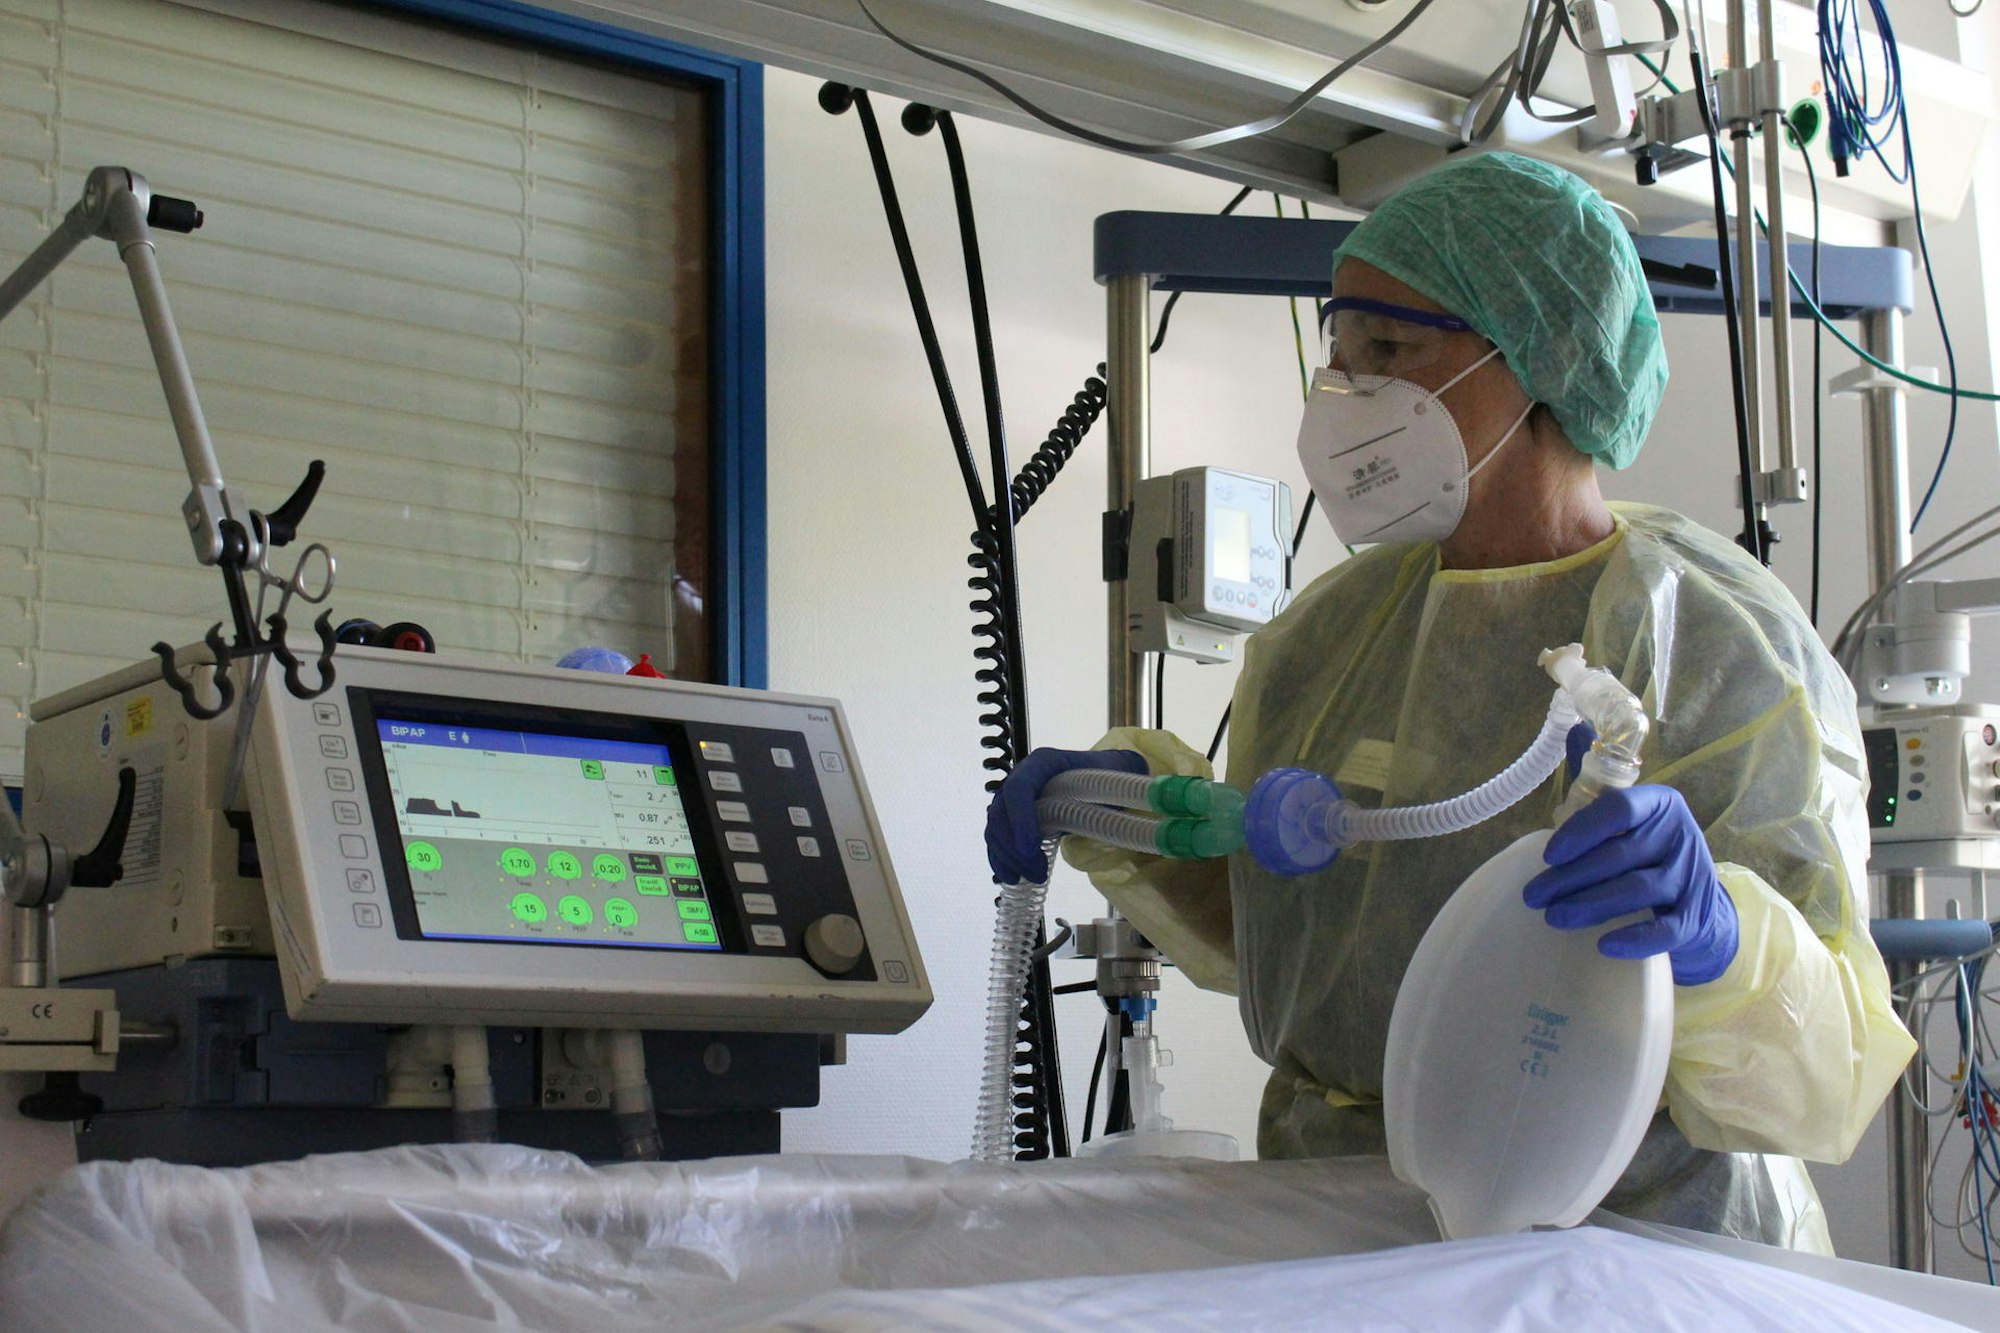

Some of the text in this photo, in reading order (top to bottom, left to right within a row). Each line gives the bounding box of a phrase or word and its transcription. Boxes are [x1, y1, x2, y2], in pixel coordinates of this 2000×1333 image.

[391, 725, 426, 738] BIPAP
[636, 769, 648, 779] 11
[646, 791, 655, 801] 2
[638, 812, 659, 823] 0.87
[417, 851, 432, 863] 30
[509, 858, 531, 869] 1.70
[559, 861, 573, 872] 12
[599, 863, 622, 874] 0.20
[524, 903, 538, 914] 15
[573, 906, 581, 916] 5
[614, 914, 622, 924] 0
[31, 1003, 53, 1020] CE
